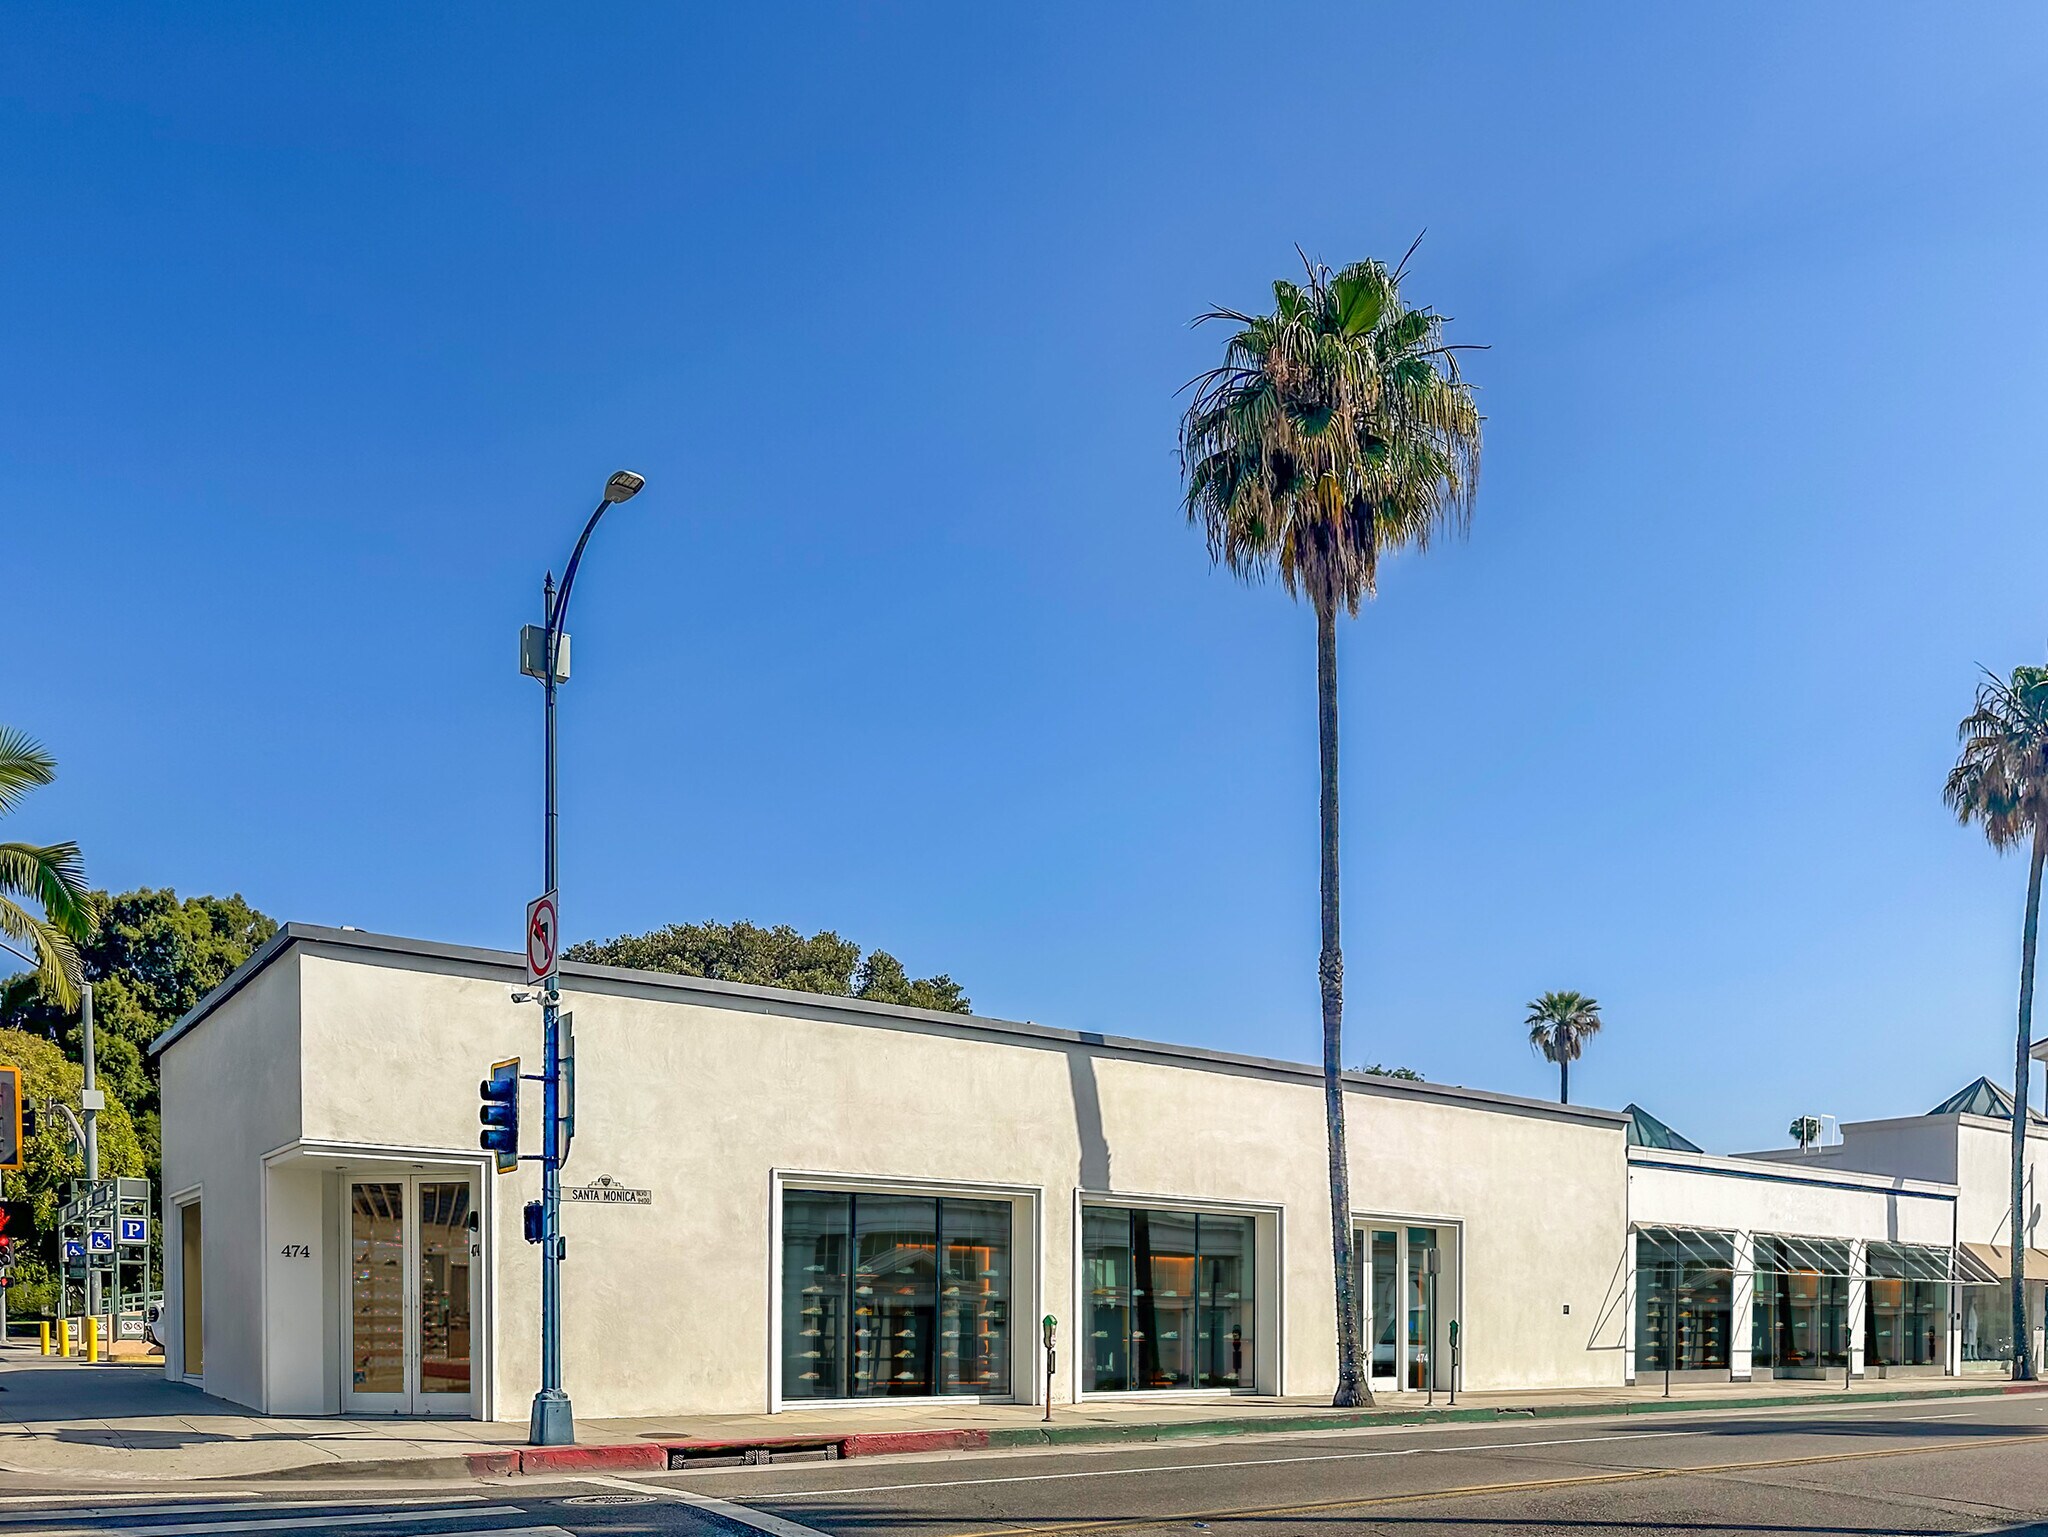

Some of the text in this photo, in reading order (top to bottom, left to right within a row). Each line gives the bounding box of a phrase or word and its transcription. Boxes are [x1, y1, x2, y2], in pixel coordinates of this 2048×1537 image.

[572, 1189, 636, 1202] SANTA MONICA
[127, 1222, 140, 1237] P
[281, 1244, 310, 1258] 474
[1415, 1353, 1428, 1363] 474
